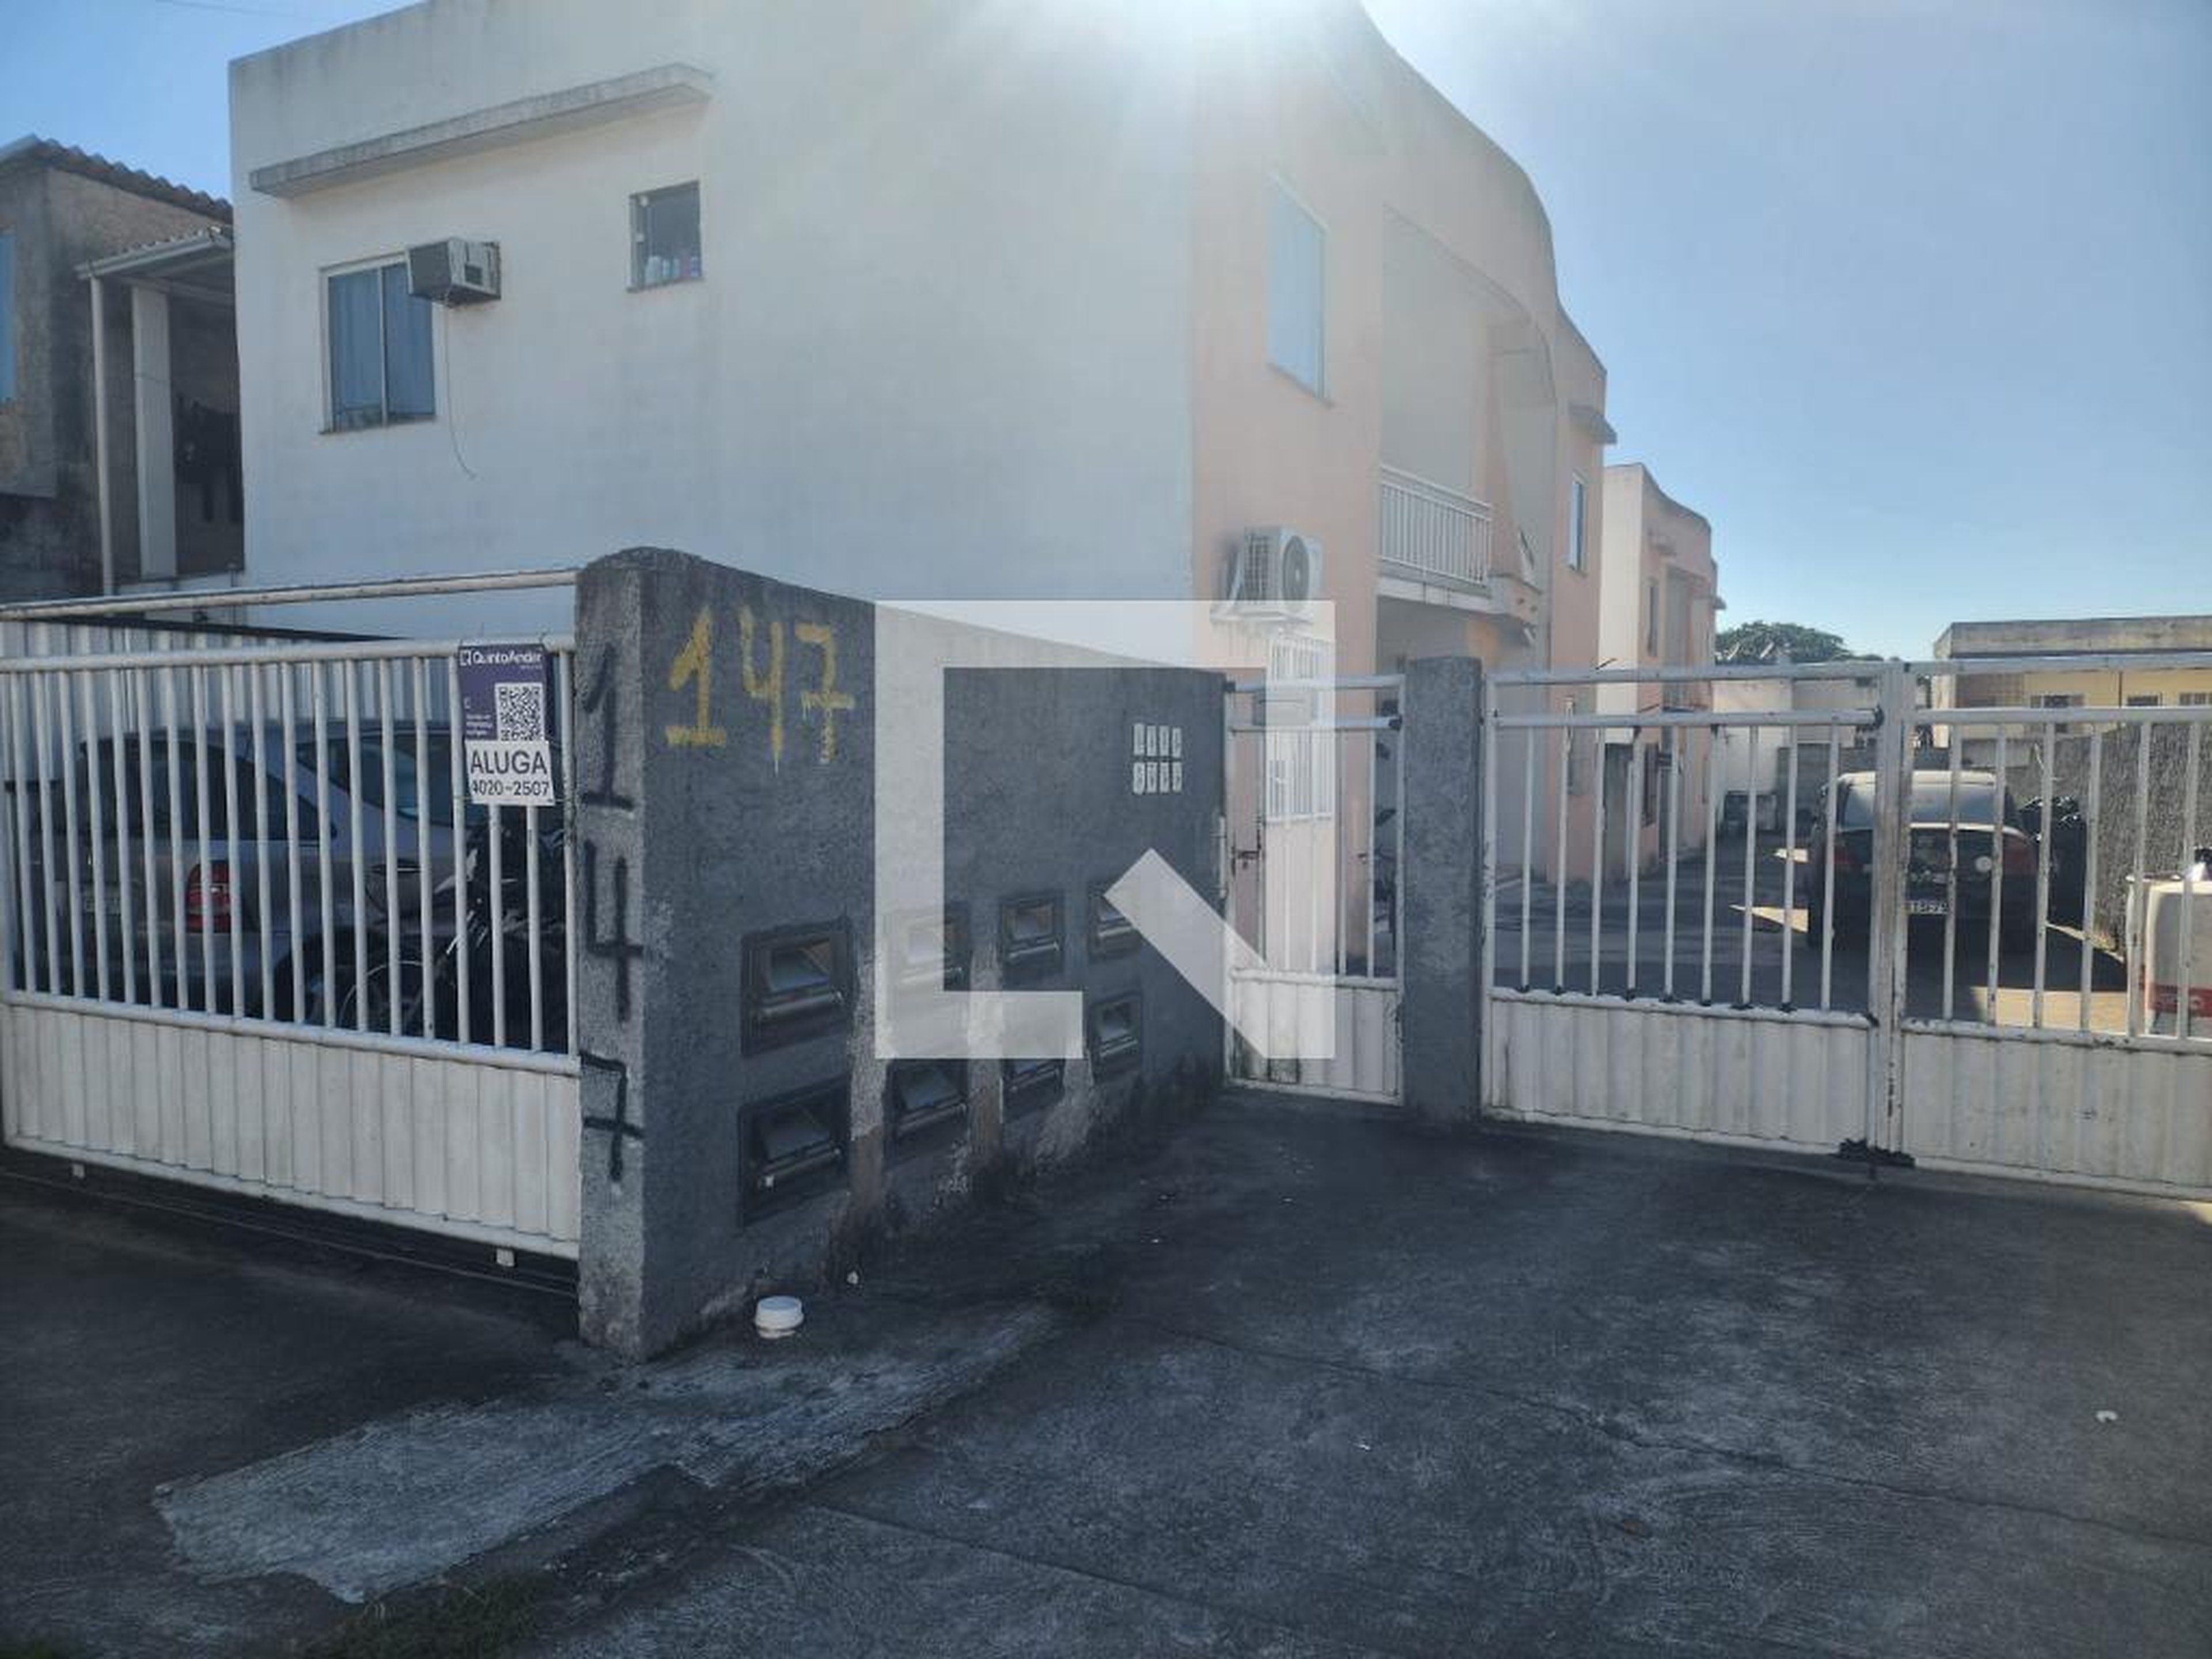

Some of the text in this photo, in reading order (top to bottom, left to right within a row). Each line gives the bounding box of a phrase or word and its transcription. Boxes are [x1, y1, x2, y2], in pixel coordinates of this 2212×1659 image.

[665, 604, 856, 768] 147
[470, 750, 547, 775] ALUGA
[472, 779, 550, 796] 4020-2507
[578, 641, 644, 1182] 147
